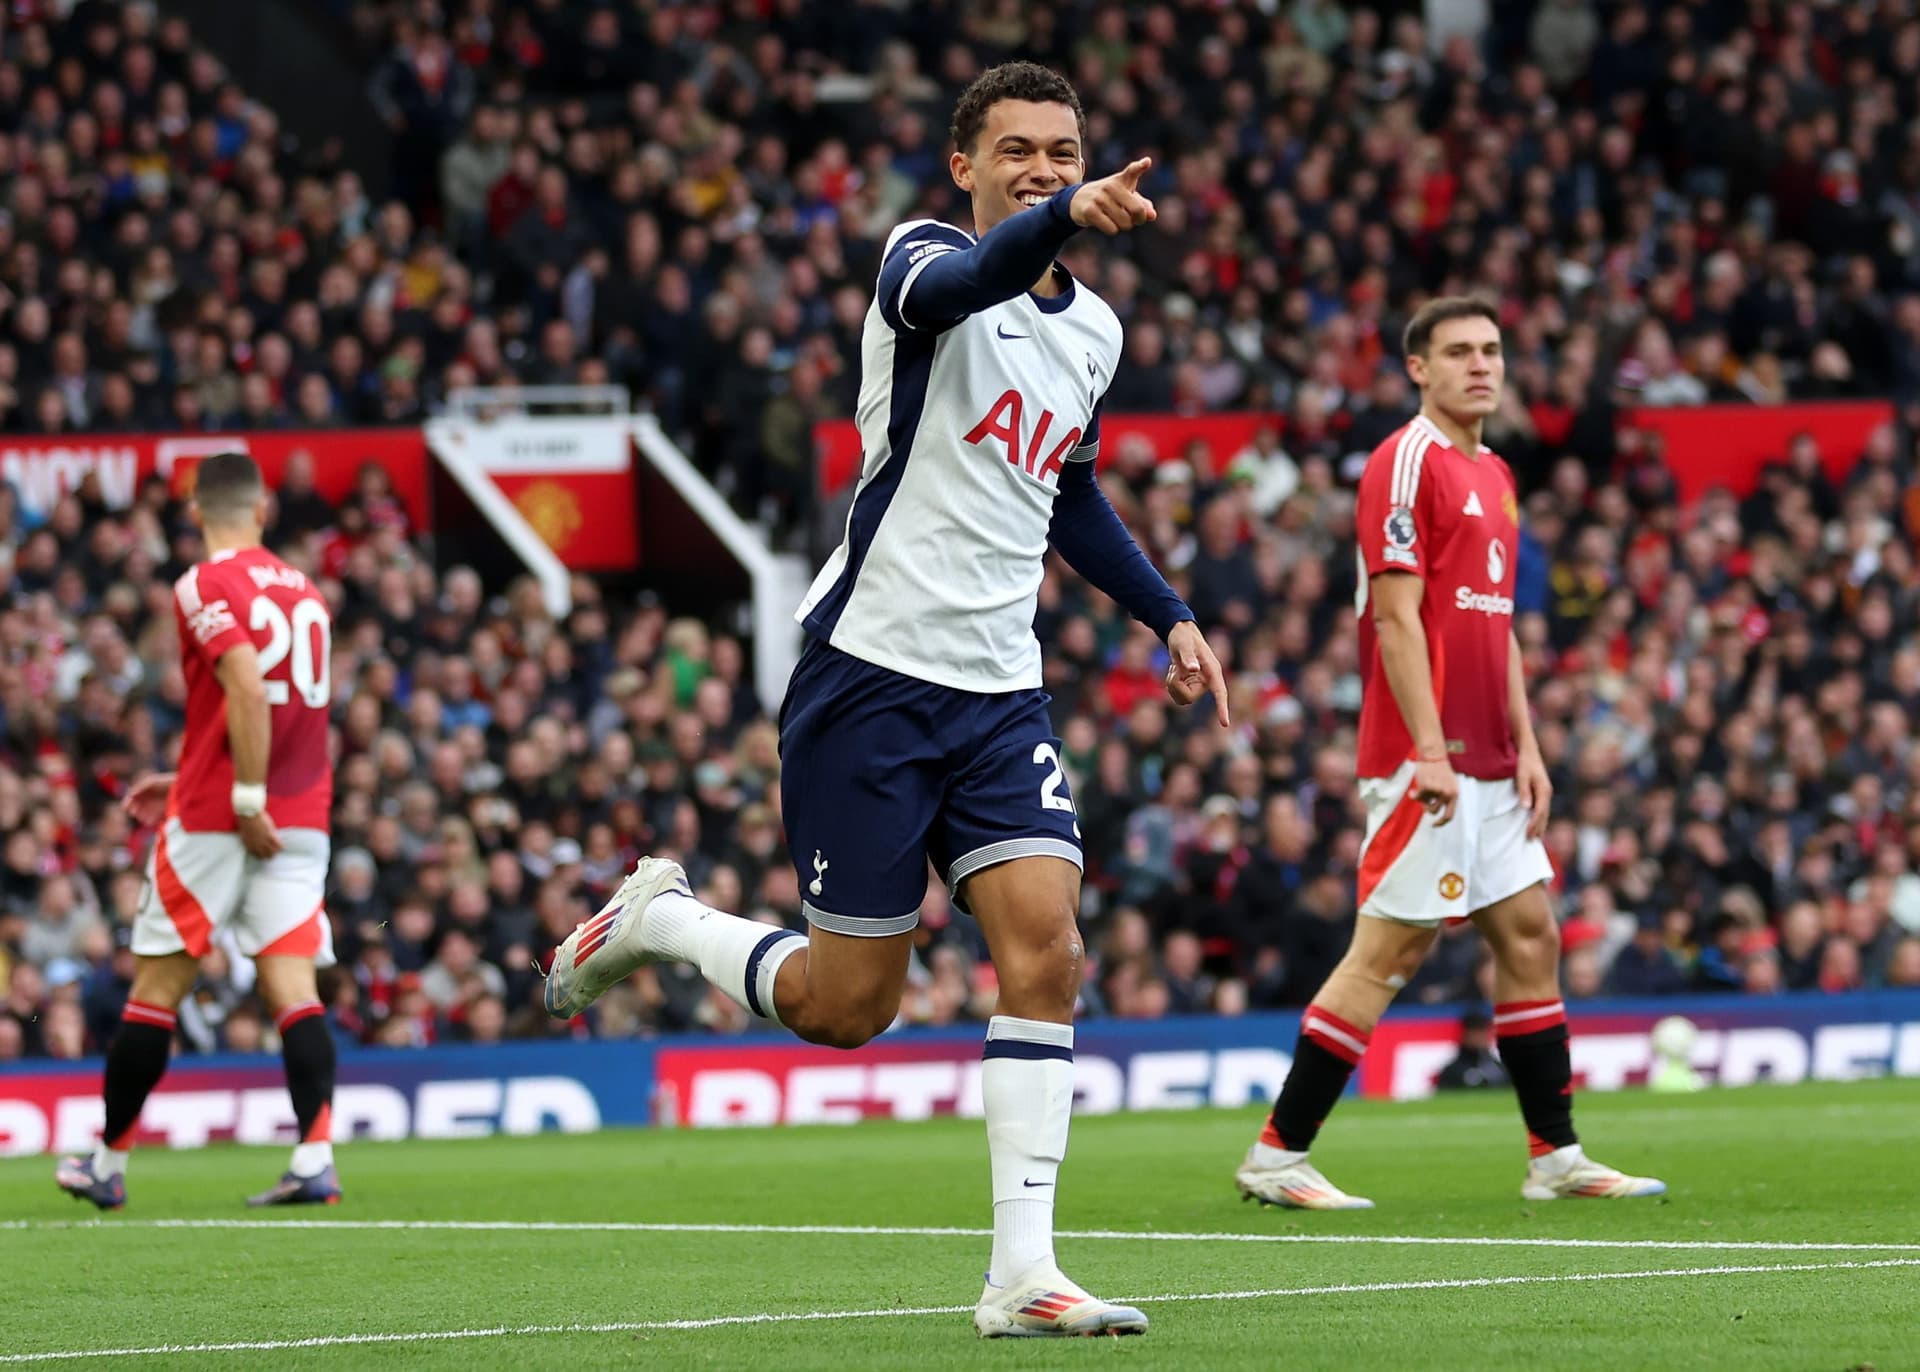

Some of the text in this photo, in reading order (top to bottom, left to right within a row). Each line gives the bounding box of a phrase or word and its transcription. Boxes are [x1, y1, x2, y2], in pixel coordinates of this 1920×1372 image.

[962, 389, 1081, 481] AIA
[250, 595, 331, 708] 20
[1033, 741, 1078, 817] 2
